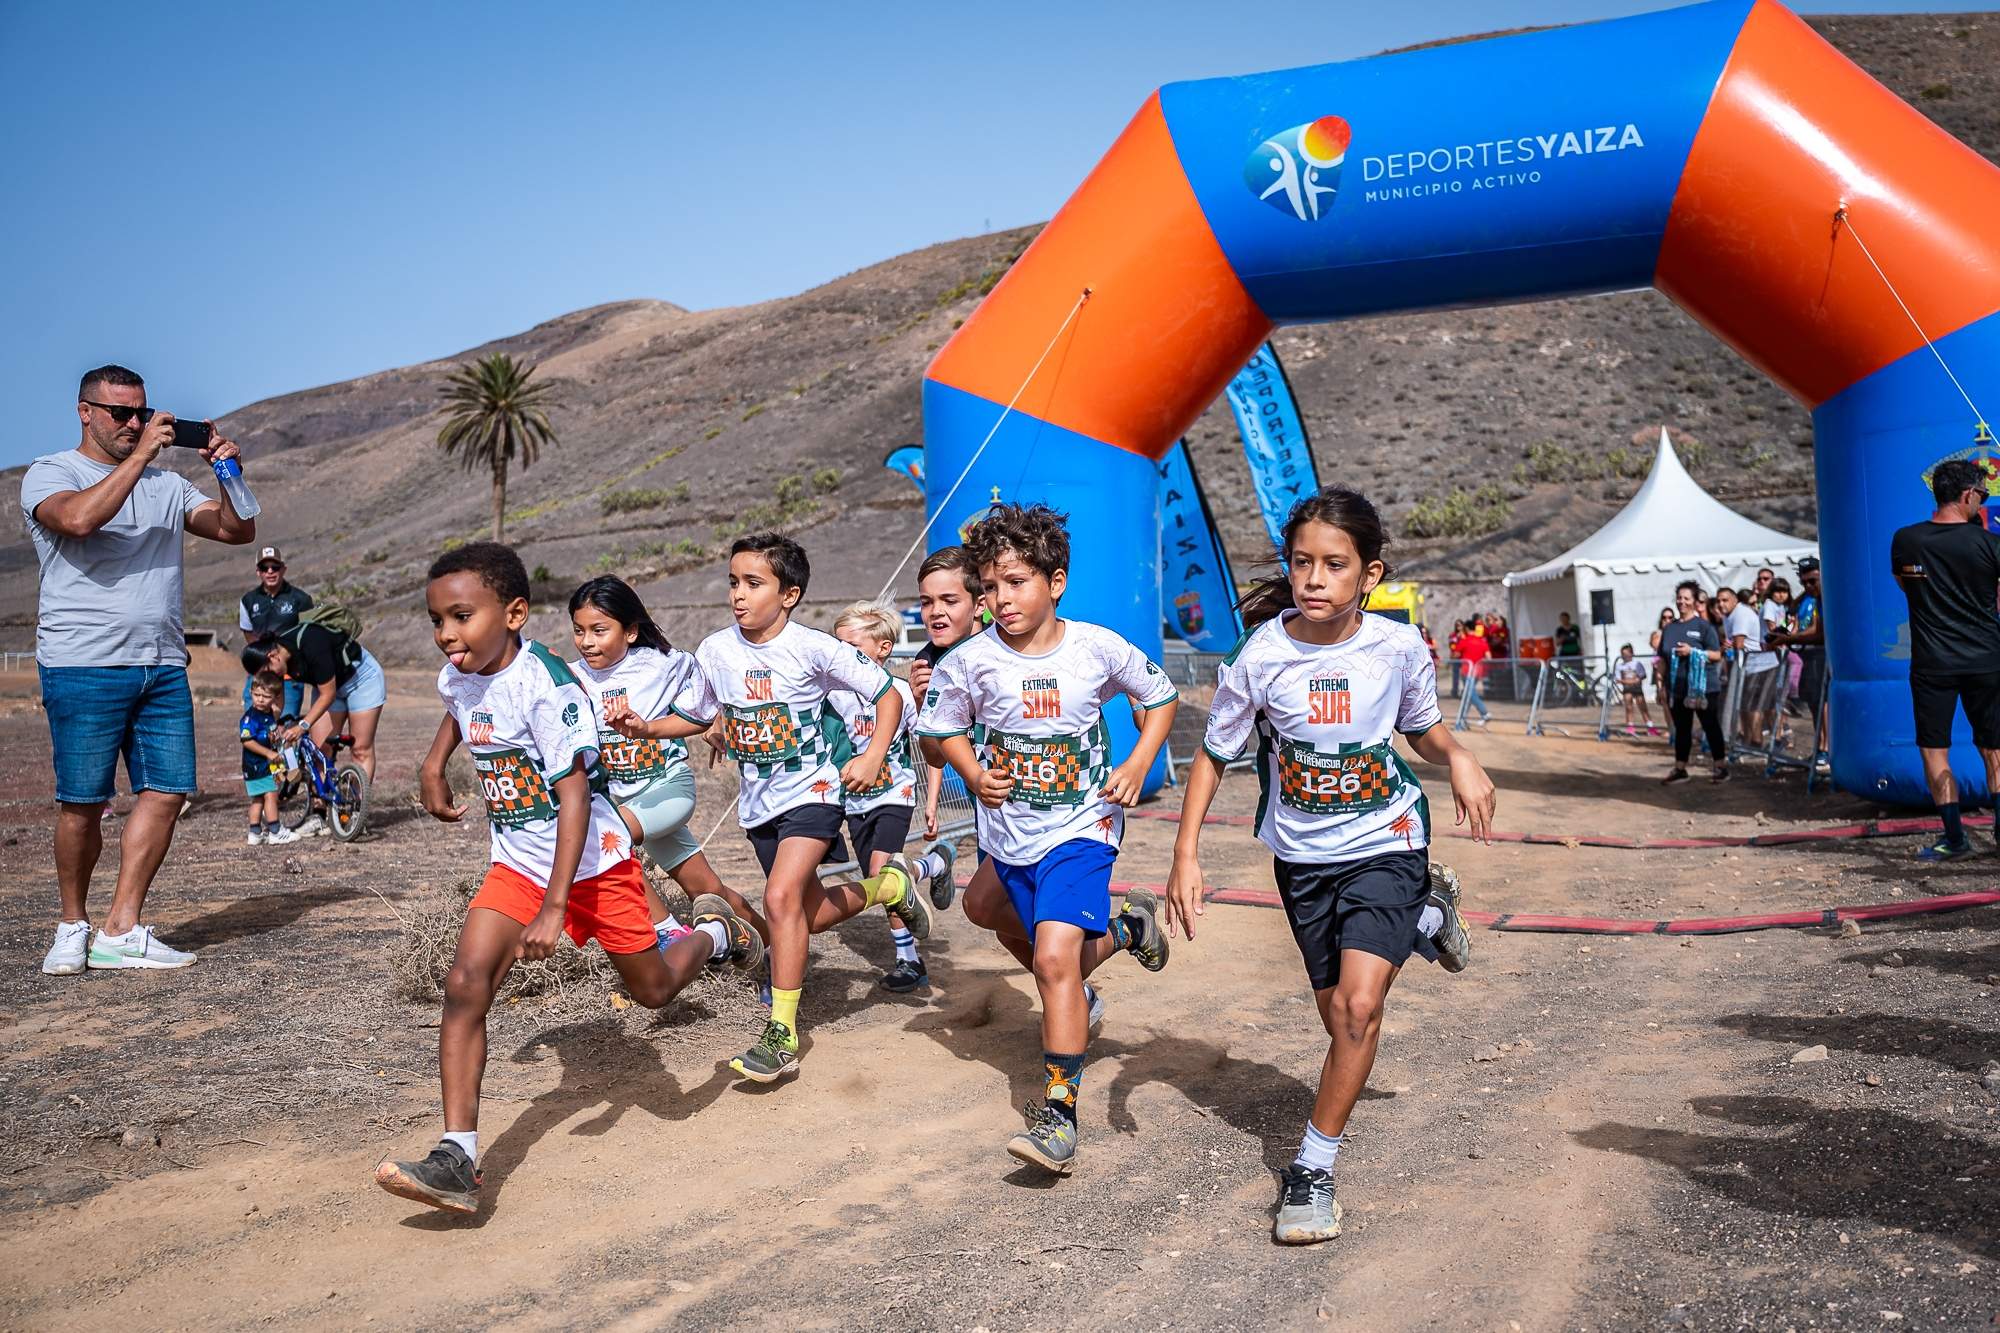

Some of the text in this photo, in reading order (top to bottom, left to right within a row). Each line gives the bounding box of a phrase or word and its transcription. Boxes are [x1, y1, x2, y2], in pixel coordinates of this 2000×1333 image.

[1365, 171, 1542, 203] MUNICIPIO ACTIVO
[746, 669, 772, 679] EXTREMO
[1023, 678, 1057, 690] EXTREMO
[1309, 678, 1349, 692] EXTREMO
[745, 679, 773, 701] SUR
[1022, 689, 1061, 719] SUR
[1308, 691, 1351, 725] SUR
[736, 724, 776, 745] 124
[602, 744, 641, 765] 117
[1009, 757, 1056, 782] 116
[1300, 771, 1361, 794] 126
